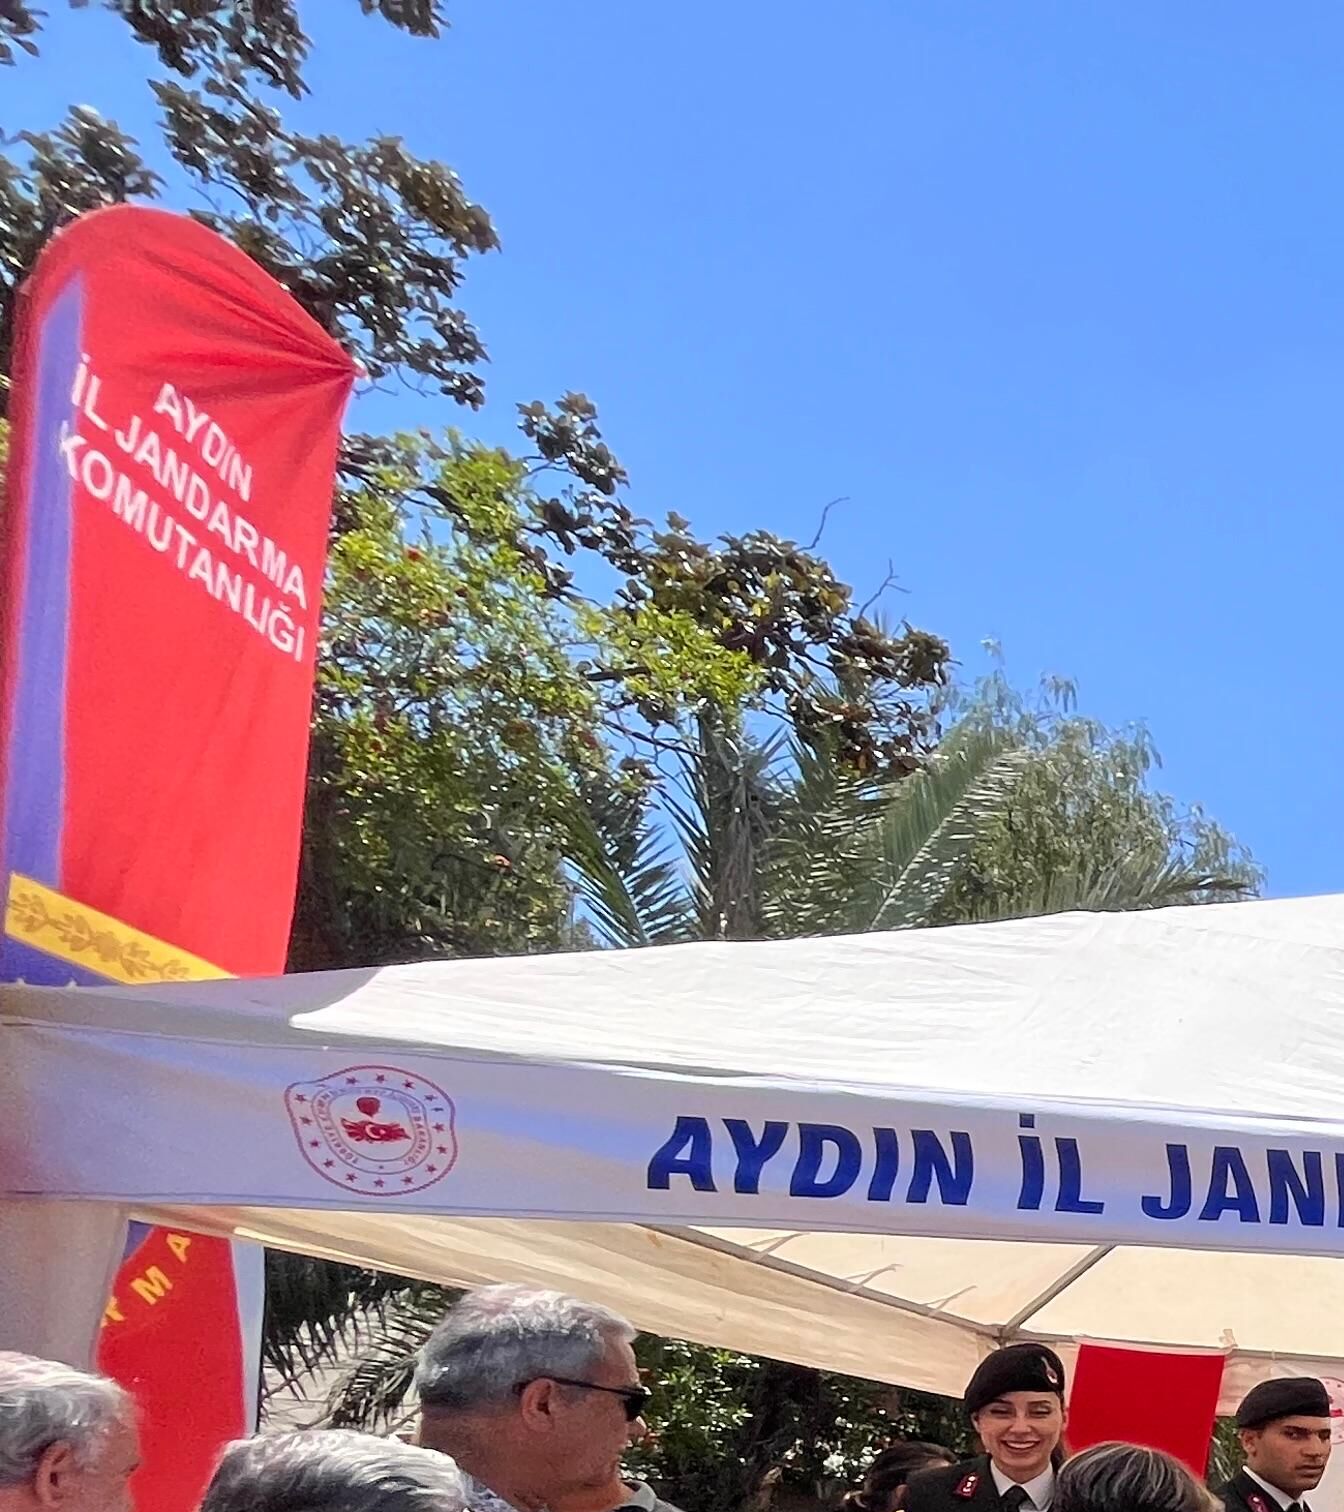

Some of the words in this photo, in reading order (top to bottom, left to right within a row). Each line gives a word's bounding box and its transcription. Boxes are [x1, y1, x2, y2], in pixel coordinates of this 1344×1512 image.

[70, 353, 107, 429] İL
[114, 416, 309, 610] JANDARMA
[153, 381, 253, 502] AYDIN
[58, 420, 305, 663] KOMUTANLIĞI
[647, 1116, 975, 1206] AYDIN
[1016, 1113, 1105, 1214] İL
